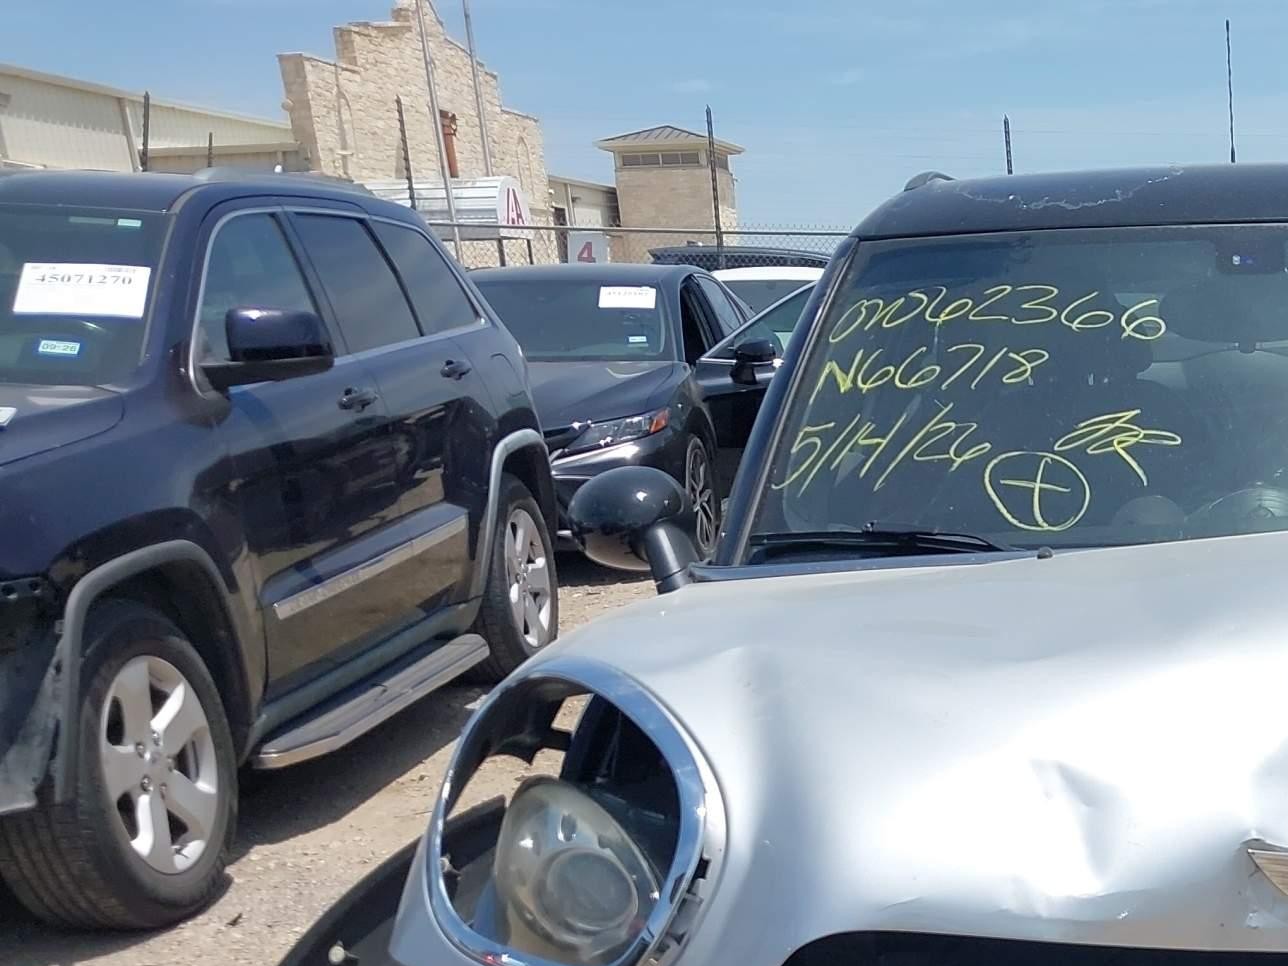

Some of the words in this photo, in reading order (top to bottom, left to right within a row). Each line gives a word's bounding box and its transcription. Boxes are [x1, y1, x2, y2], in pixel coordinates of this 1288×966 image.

[506, 187, 526, 225] IAA
[577, 241, 596, 263] 4
[35, 273, 133, 286] 45071270
